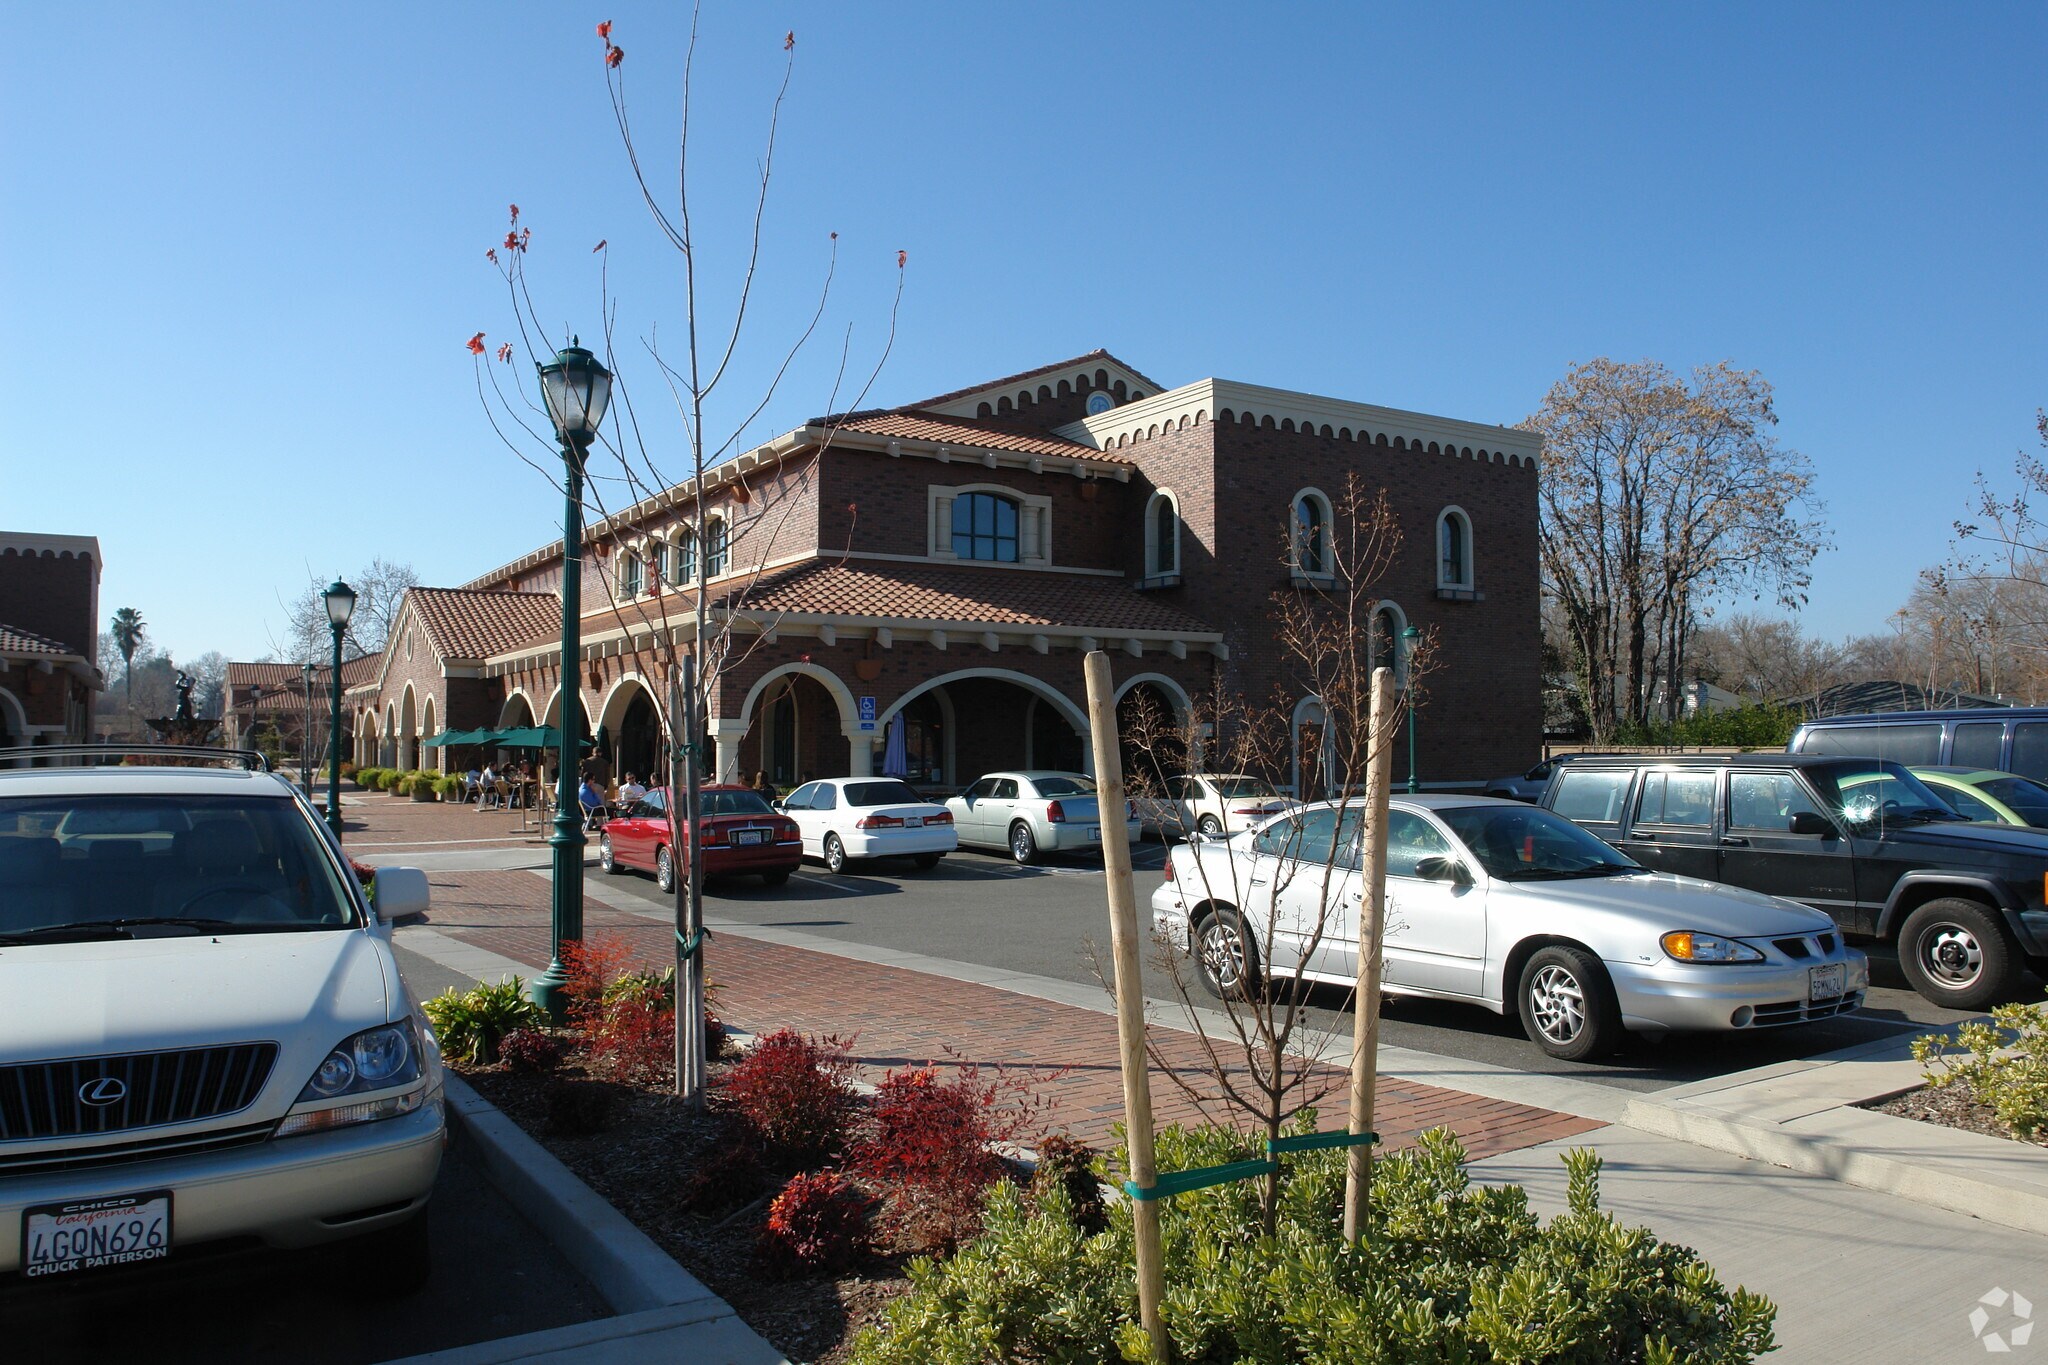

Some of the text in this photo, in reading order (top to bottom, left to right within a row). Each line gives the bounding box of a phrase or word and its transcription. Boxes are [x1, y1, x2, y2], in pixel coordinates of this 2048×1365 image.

[55, 1206, 146, 1226] California
[62, 1198, 136, 1213] CHICO
[32, 1217, 162, 1264] 4GQN696
[26, 1247, 167, 1277] CHUCK PATTERSON
